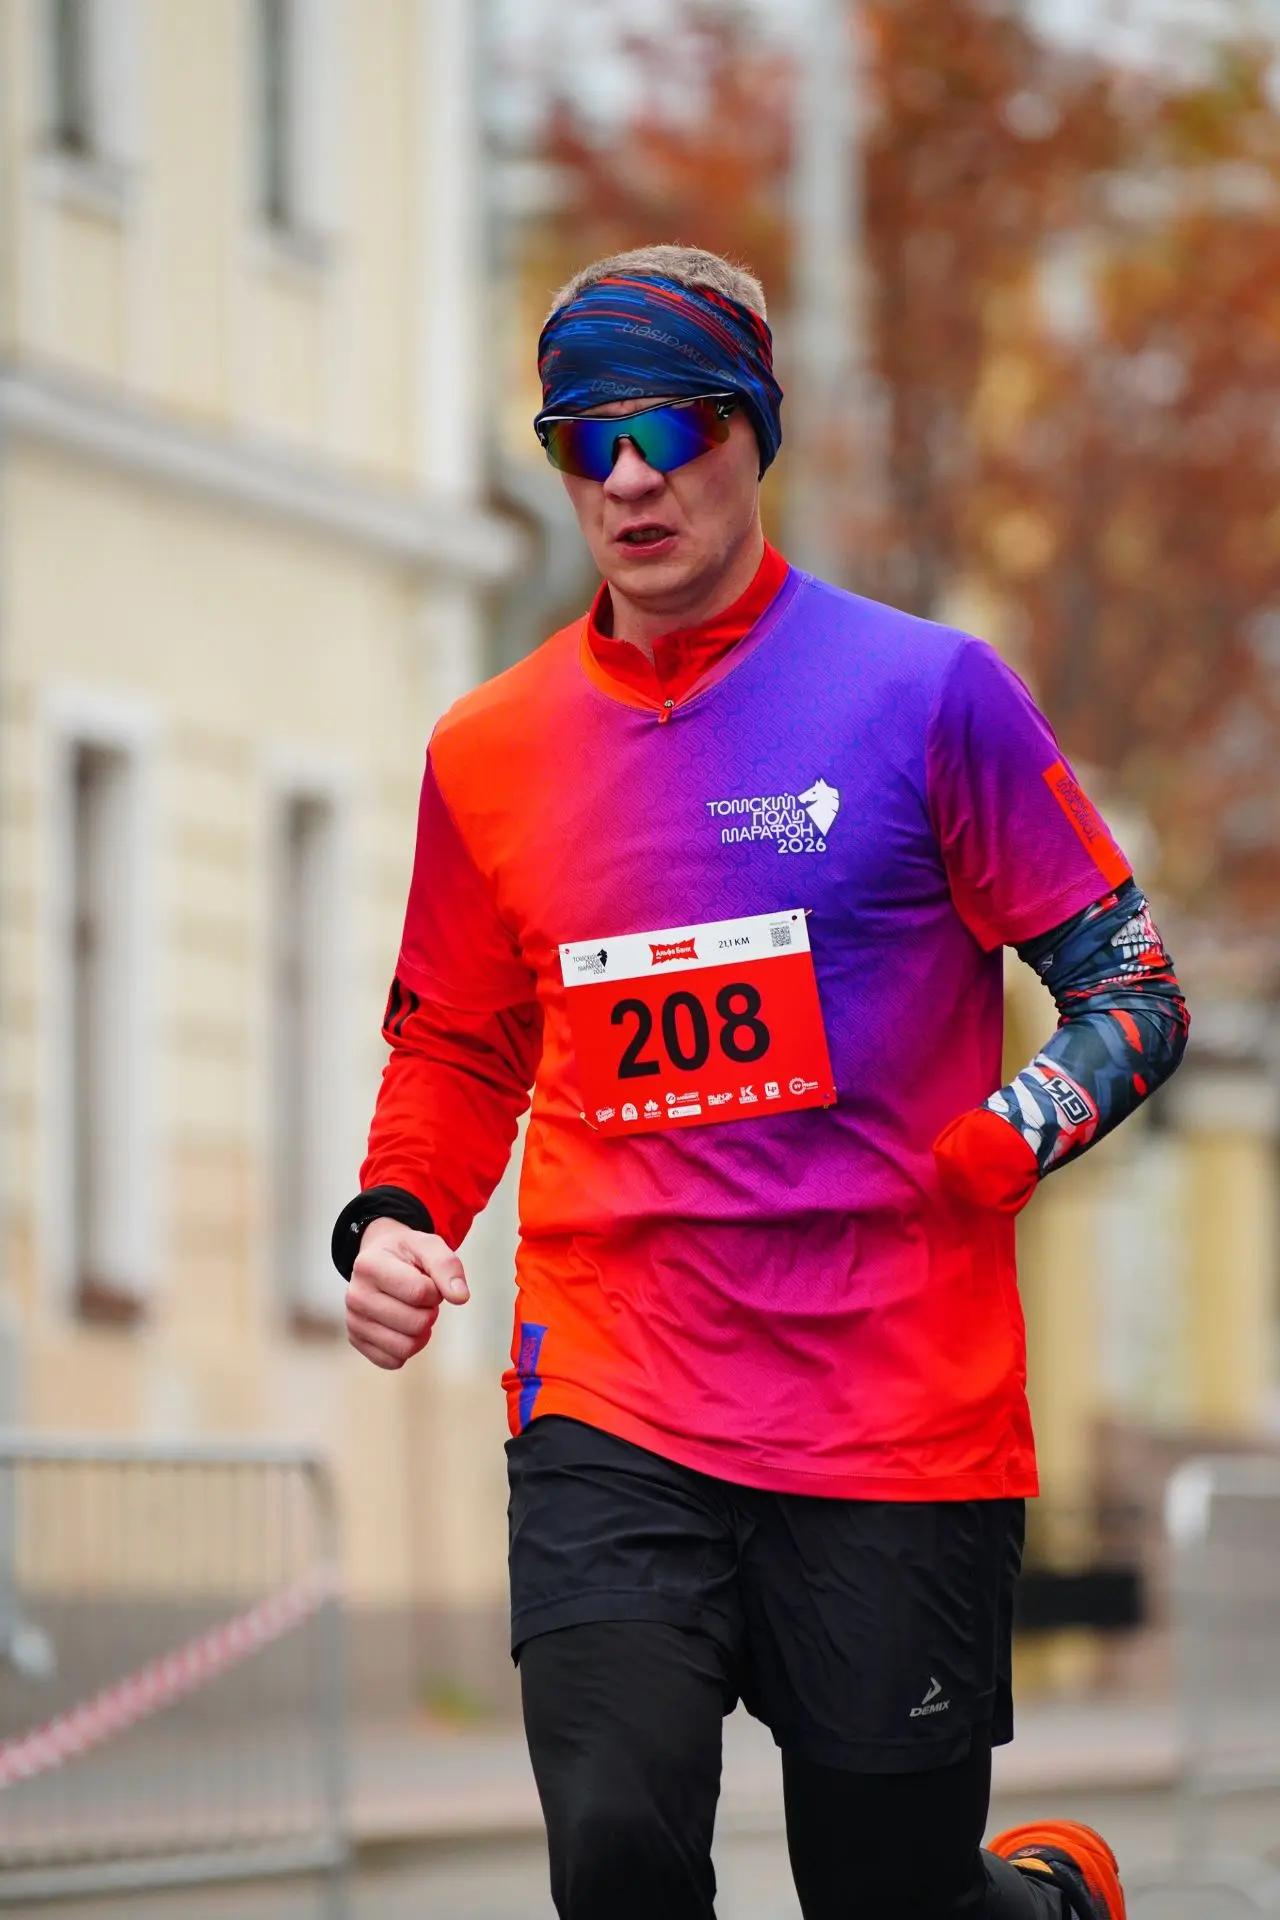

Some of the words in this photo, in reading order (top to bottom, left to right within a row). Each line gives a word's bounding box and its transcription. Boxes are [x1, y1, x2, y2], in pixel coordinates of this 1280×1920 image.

[706, 792, 796, 817] ТОМСКИЙ
[721, 823, 814, 844] МАРАФОН
[777, 837, 827, 854] 2026
[610, 983, 770, 1080] 208
[909, 1699, 951, 1718] DEMIX
